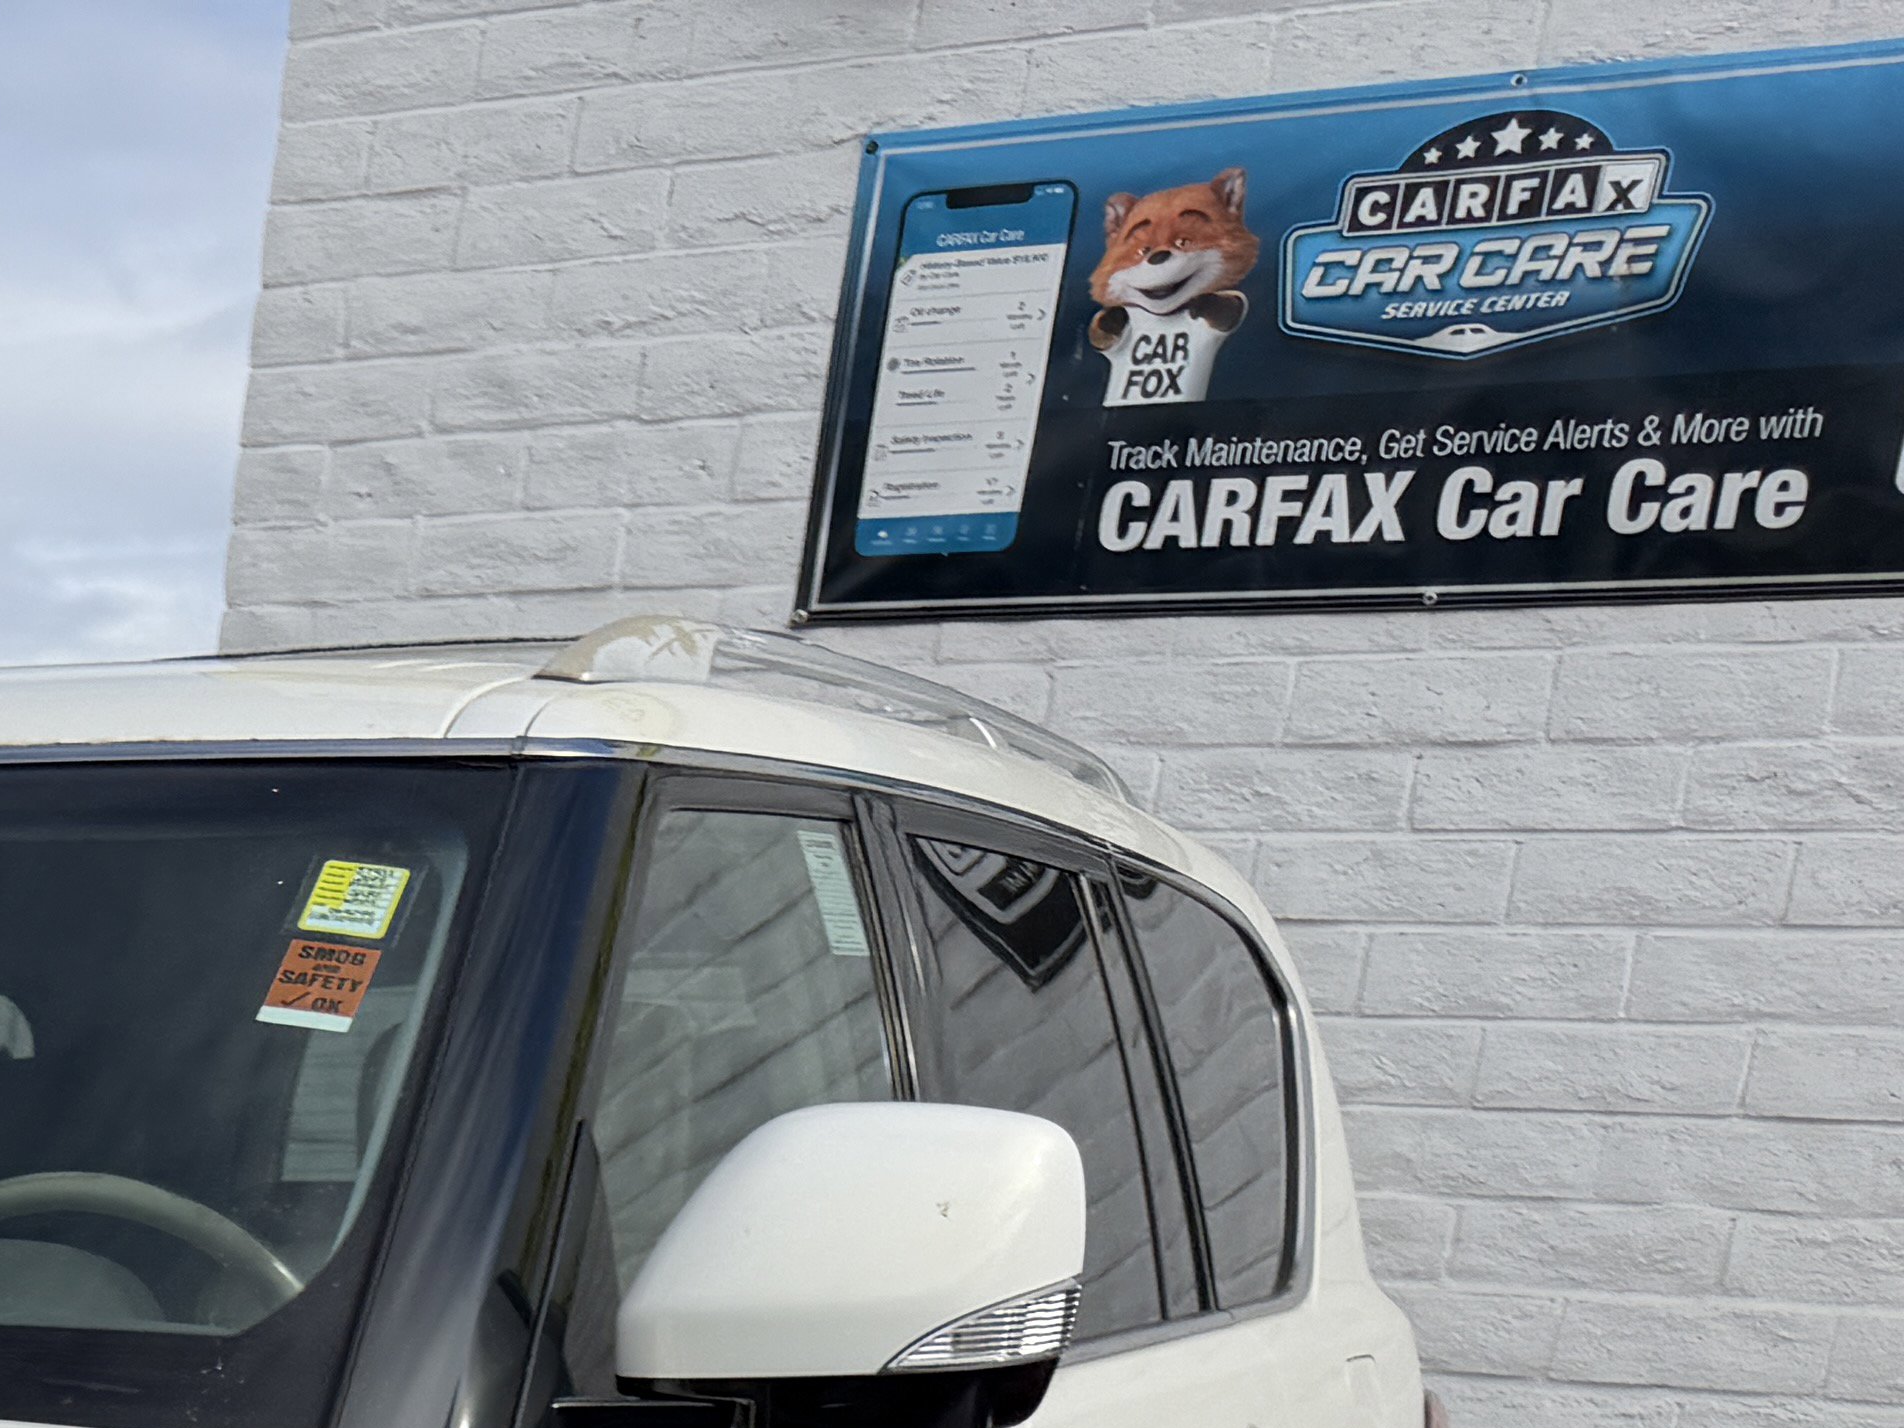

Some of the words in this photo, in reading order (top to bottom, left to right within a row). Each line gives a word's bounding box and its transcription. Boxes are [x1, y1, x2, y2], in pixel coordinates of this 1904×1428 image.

[1357, 173, 1643, 227] CARFAX
[1301, 242, 1461, 299] CAR
[1459, 225, 1671, 289] CARE
[1381, 298, 1479, 321] SERVICE
[1480, 291, 1571, 314] CENTER
[1132, 332, 1190, 366] CAR
[1122, 365, 1184, 400] FOX
[1108, 439, 1180, 471] Track
[1185, 434, 1369, 468] Maintenance,
[1379, 427, 1427, 460] Get
[1433, 422, 1539, 457] Service
[1543, 418, 1630, 452] Alerts
[1637, 414, 1662, 447] &
[1671, 412, 1749, 445] More
[1759, 406, 1824, 439] with
[1097, 469, 1417, 553] CARFAX
[1436, 464, 1585, 541] Car
[1606, 457, 1810, 535] Care
[278, 969, 363, 993] SAFETY
